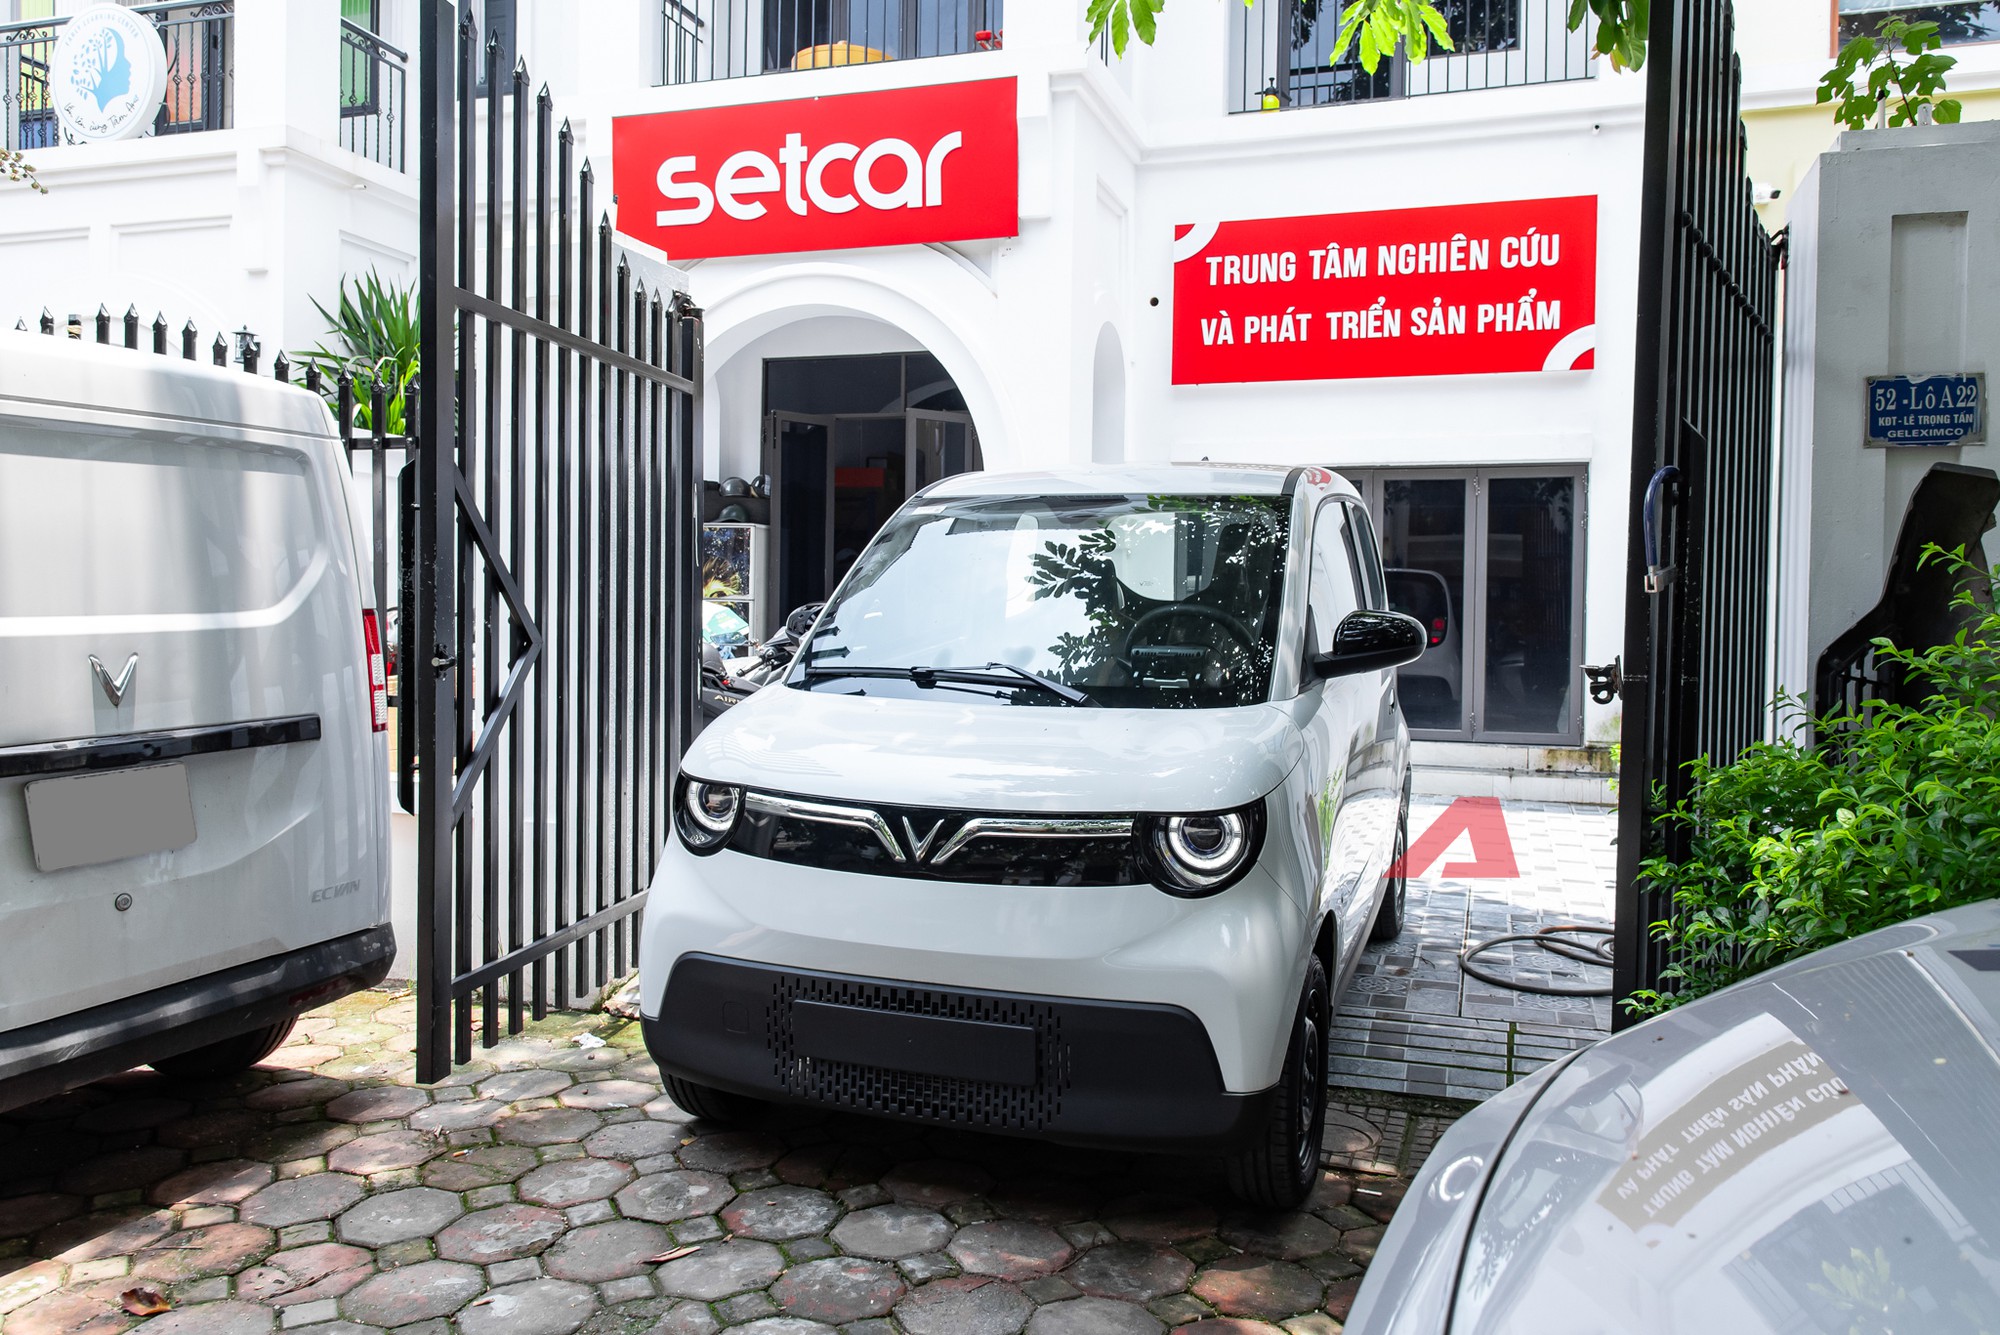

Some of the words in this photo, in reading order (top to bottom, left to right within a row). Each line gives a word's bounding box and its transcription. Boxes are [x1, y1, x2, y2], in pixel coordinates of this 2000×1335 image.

[656, 130, 962, 227] setcar
[1206, 251, 1297, 286] TRUNG
[1309, 242, 1367, 280] TÂM
[1377, 233, 1490, 276] NGHIÊN
[1500, 227, 1560, 269] CỨU
[1200, 310, 1234, 346] VÀ
[1244, 307, 1312, 344] PHÁT
[1326, 296, 1401, 340] TRIỂN
[1411, 296, 1466, 336] SẢN
[1477, 288, 1561, 333] PHẨM
[1887, 428, 1964, 438] GELEXIMCO
[1918, 414, 1951, 426] TRỌNG
